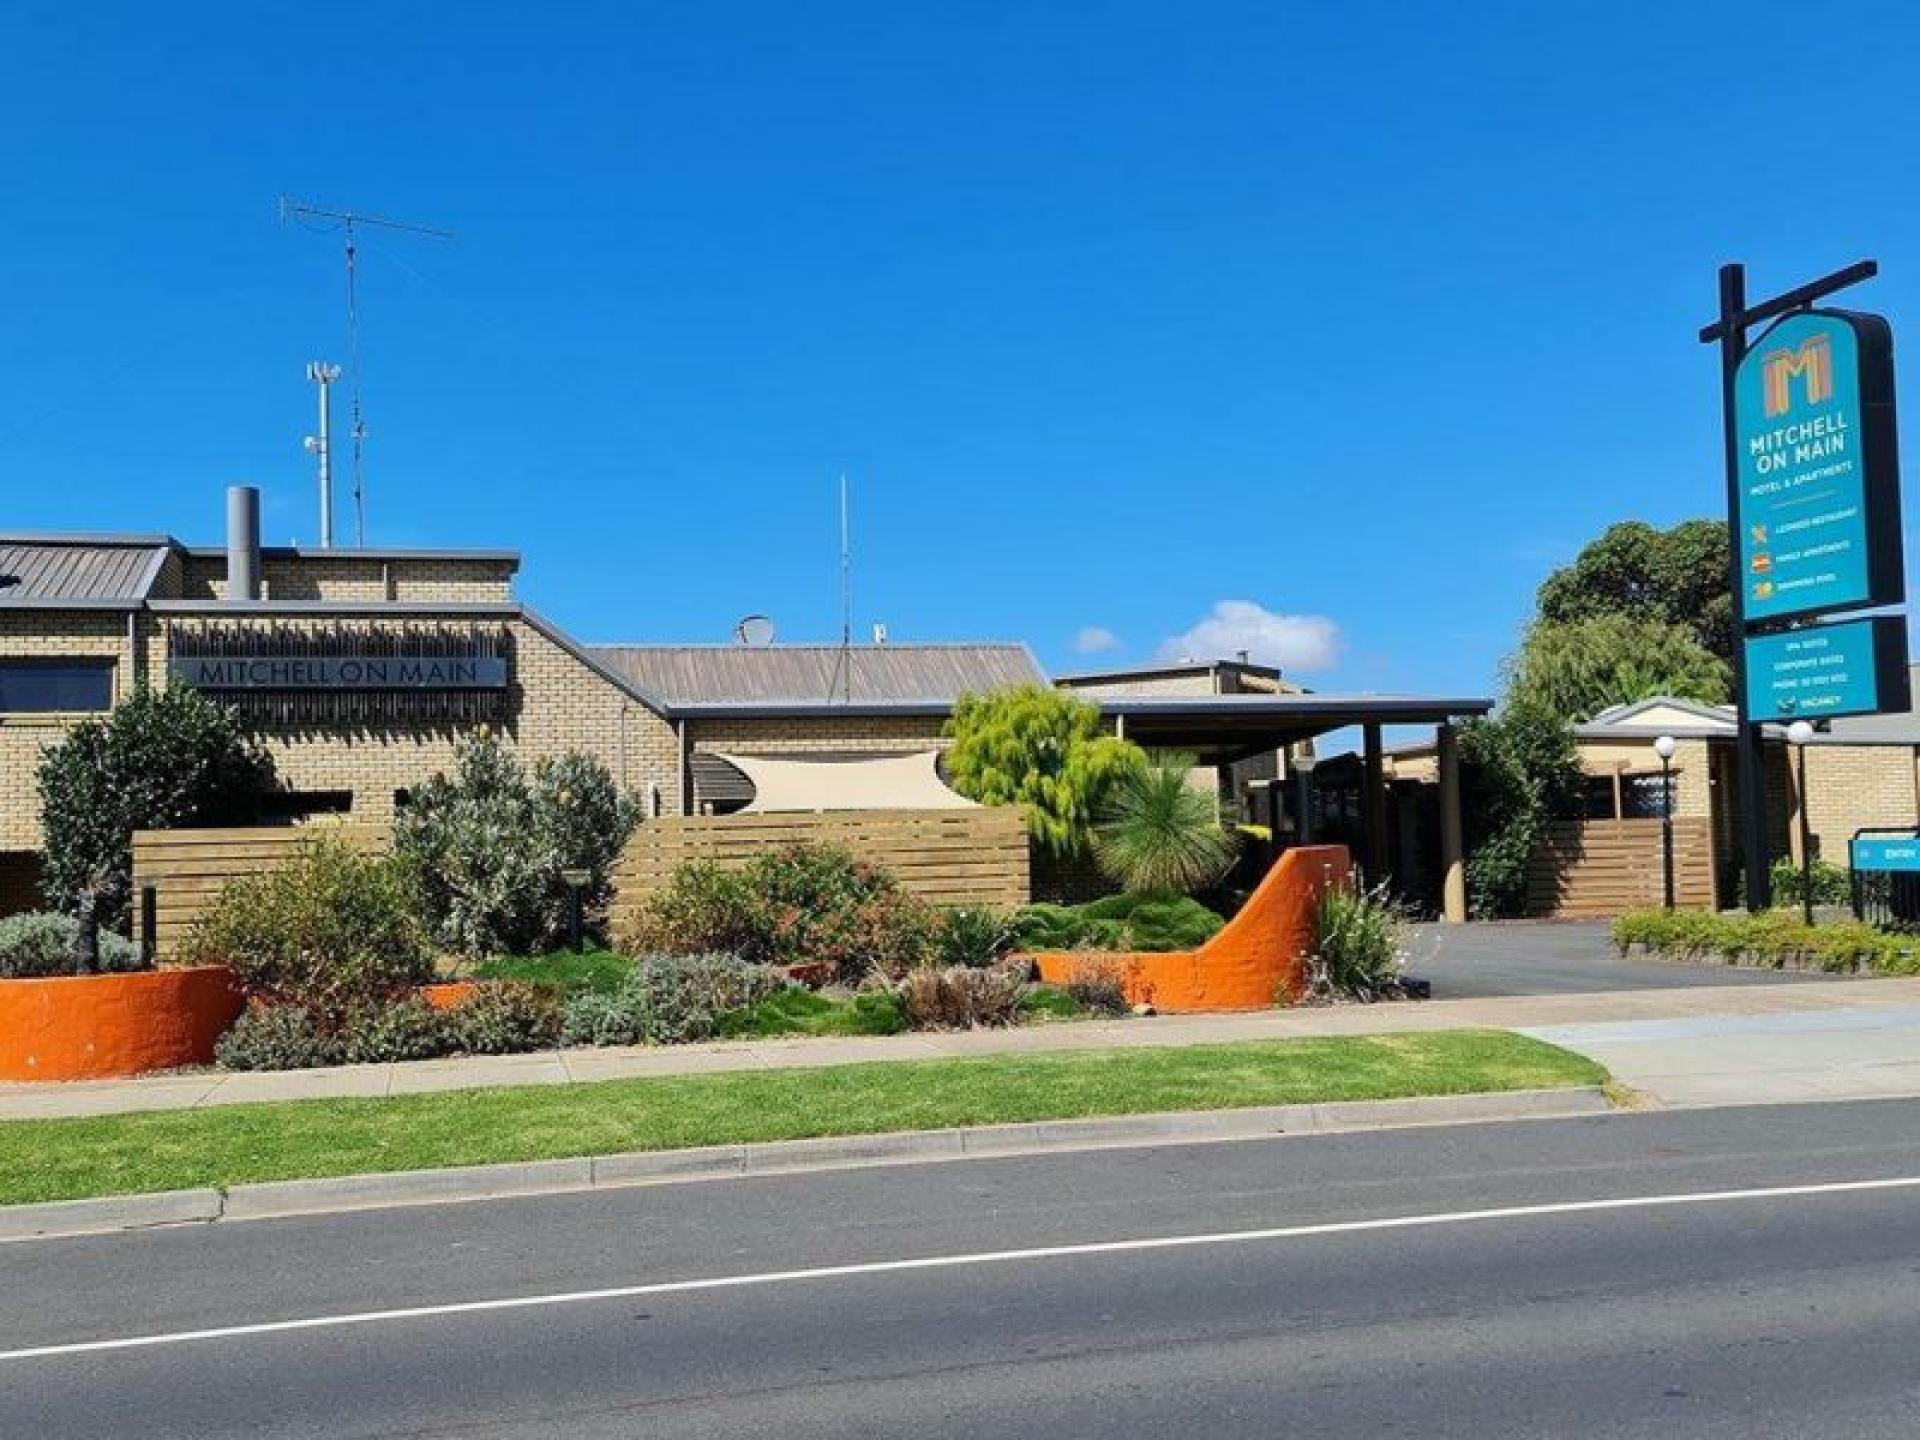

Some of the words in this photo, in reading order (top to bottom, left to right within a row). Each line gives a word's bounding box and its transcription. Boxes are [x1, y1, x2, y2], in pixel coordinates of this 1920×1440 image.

[1751, 411, 1848, 455] MITCHELL
[1756, 451, 1786, 474] ON
[1795, 432, 1843, 464] MAIN
[200, 660, 329, 684] MITCHELL
[339, 660, 387, 683] ON
[401, 660, 477, 683] MAIN
